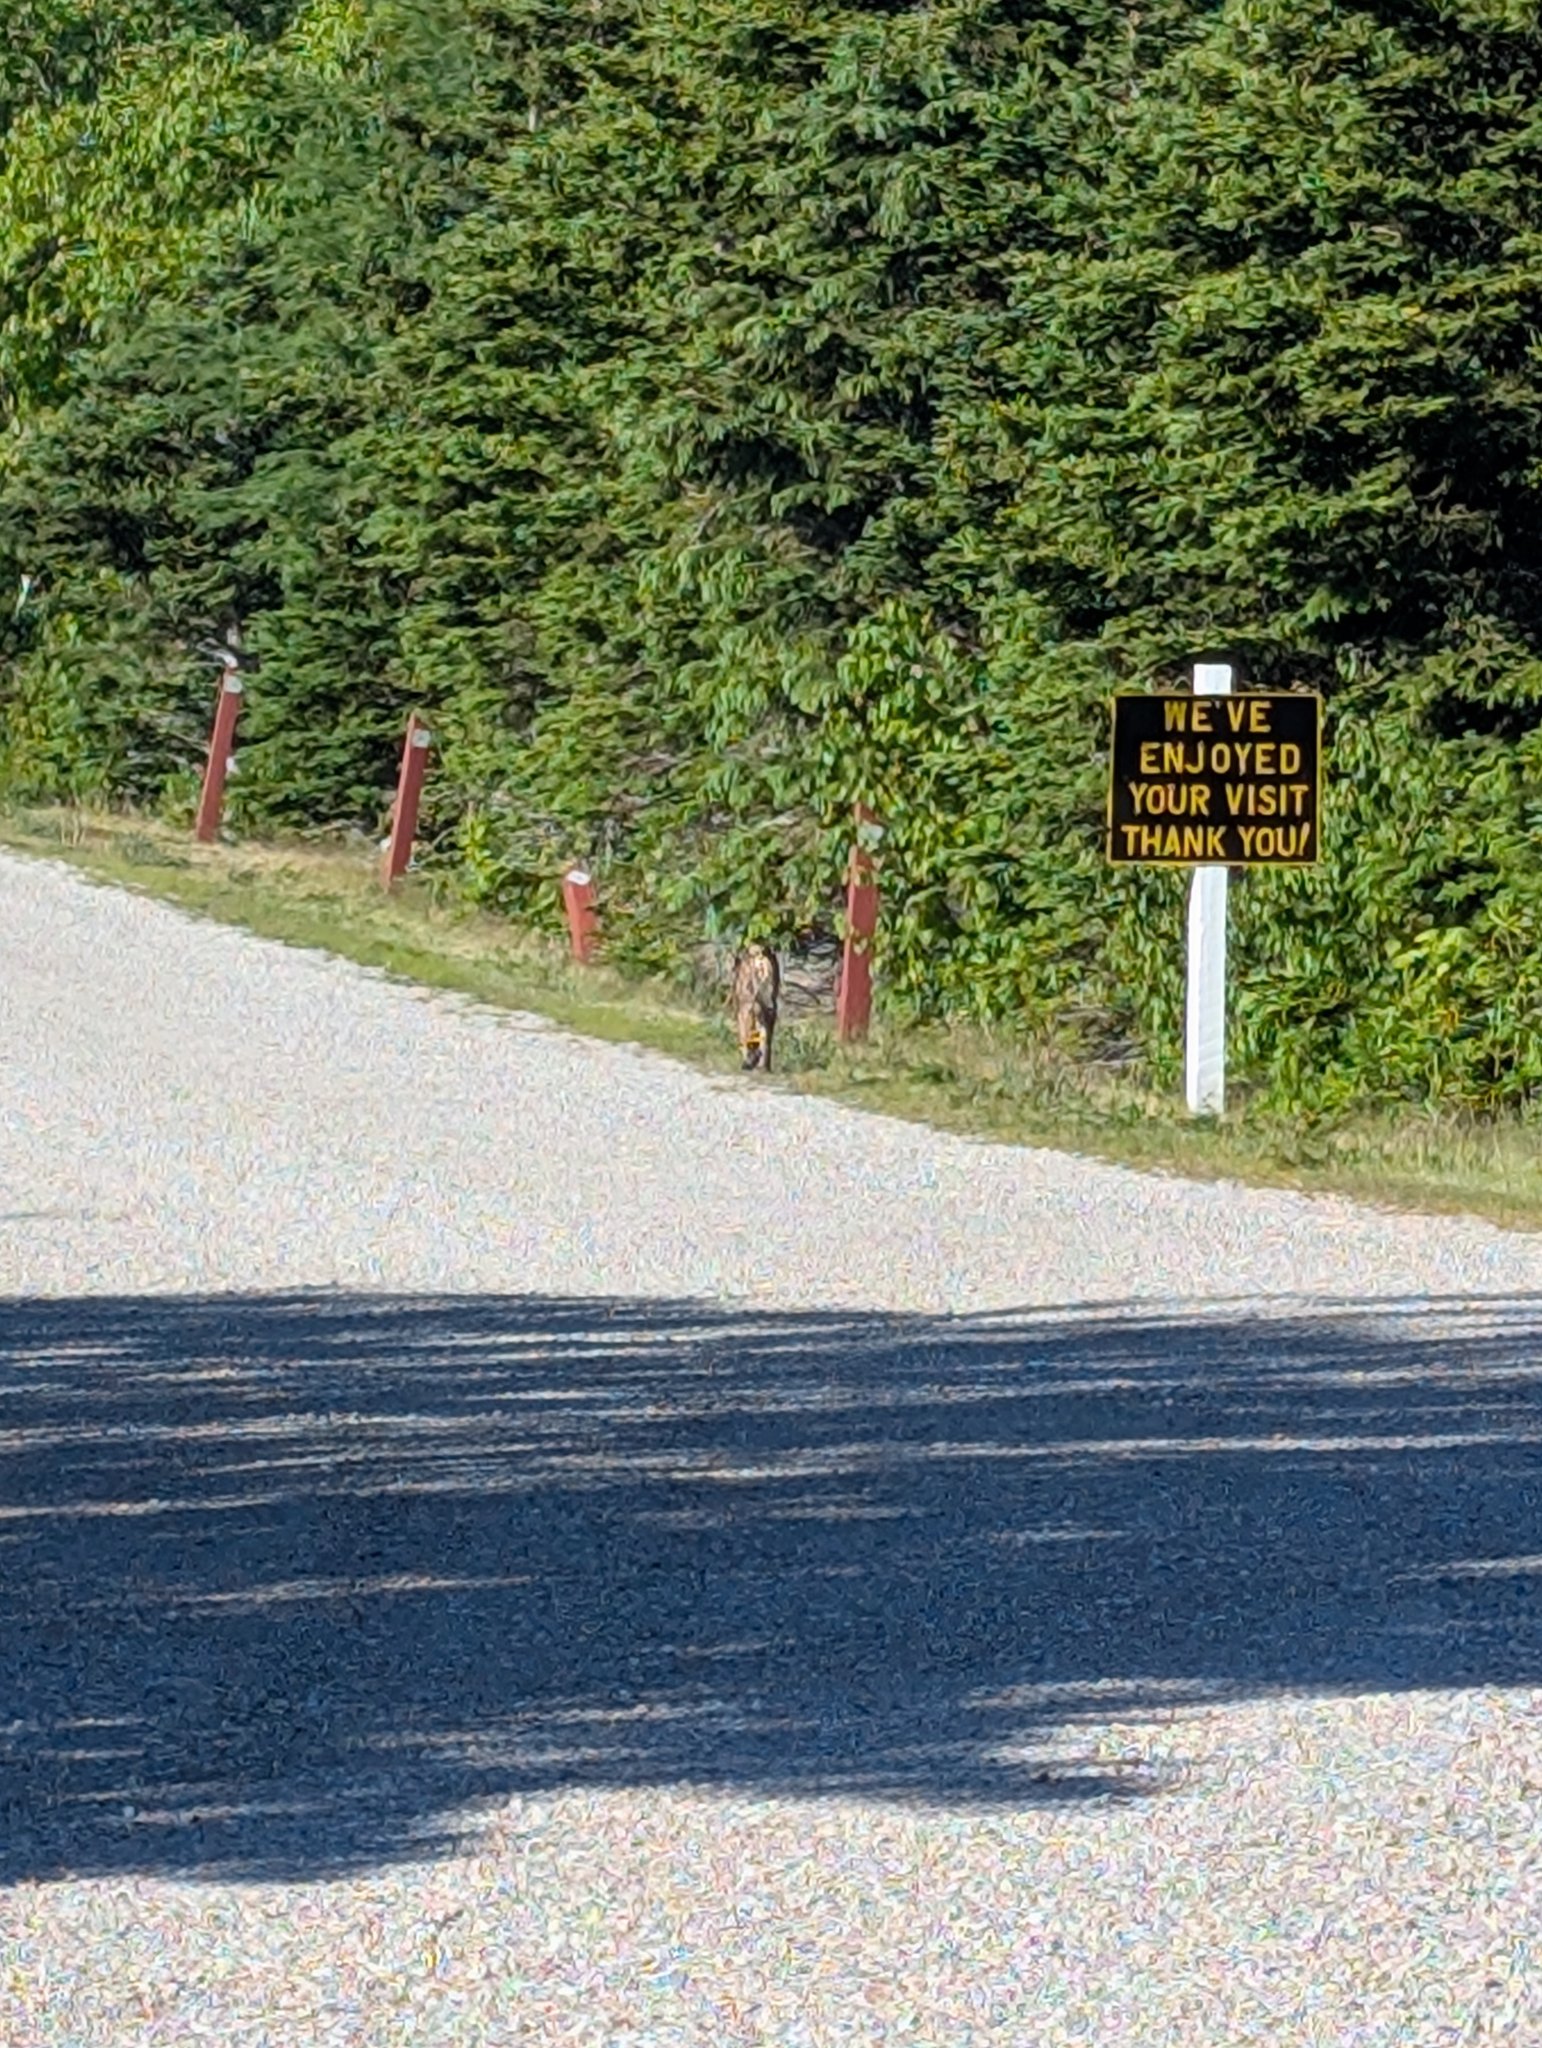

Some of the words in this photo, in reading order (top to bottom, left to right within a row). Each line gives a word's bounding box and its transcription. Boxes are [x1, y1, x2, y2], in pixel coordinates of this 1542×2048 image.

[1164, 700, 1273, 733] WE'VE
[1140, 741, 1301, 776] ENJOYED
[1128, 781, 1211, 817] YOUR
[1225, 782, 1309, 817] VISIT
[1120, 823, 1227, 857] THANK
[1237, 822, 1311, 857] YOU!
